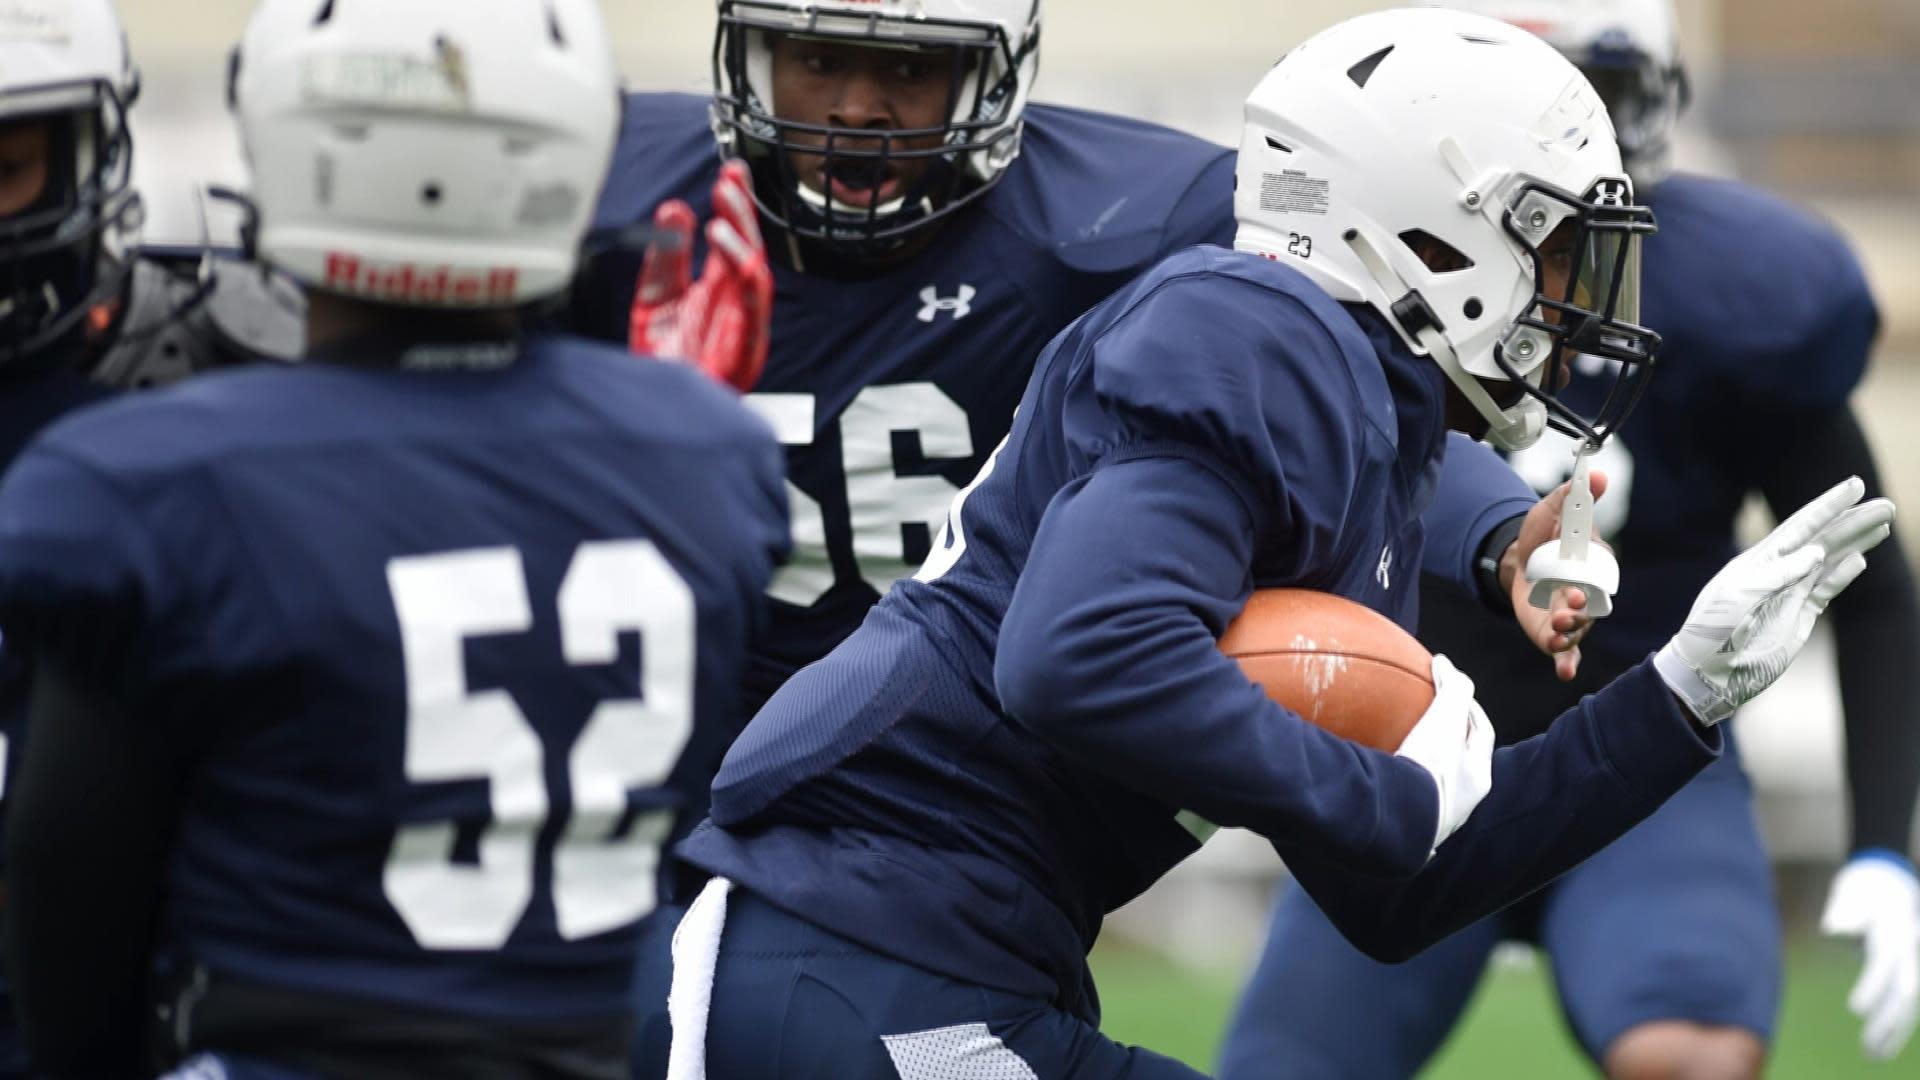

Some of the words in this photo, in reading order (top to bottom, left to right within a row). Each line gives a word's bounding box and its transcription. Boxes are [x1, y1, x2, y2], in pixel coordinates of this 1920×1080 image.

[1287, 232, 1312, 258] 23
[325, 251, 518, 301] Riddell
[382, 538, 696, 951] 52
